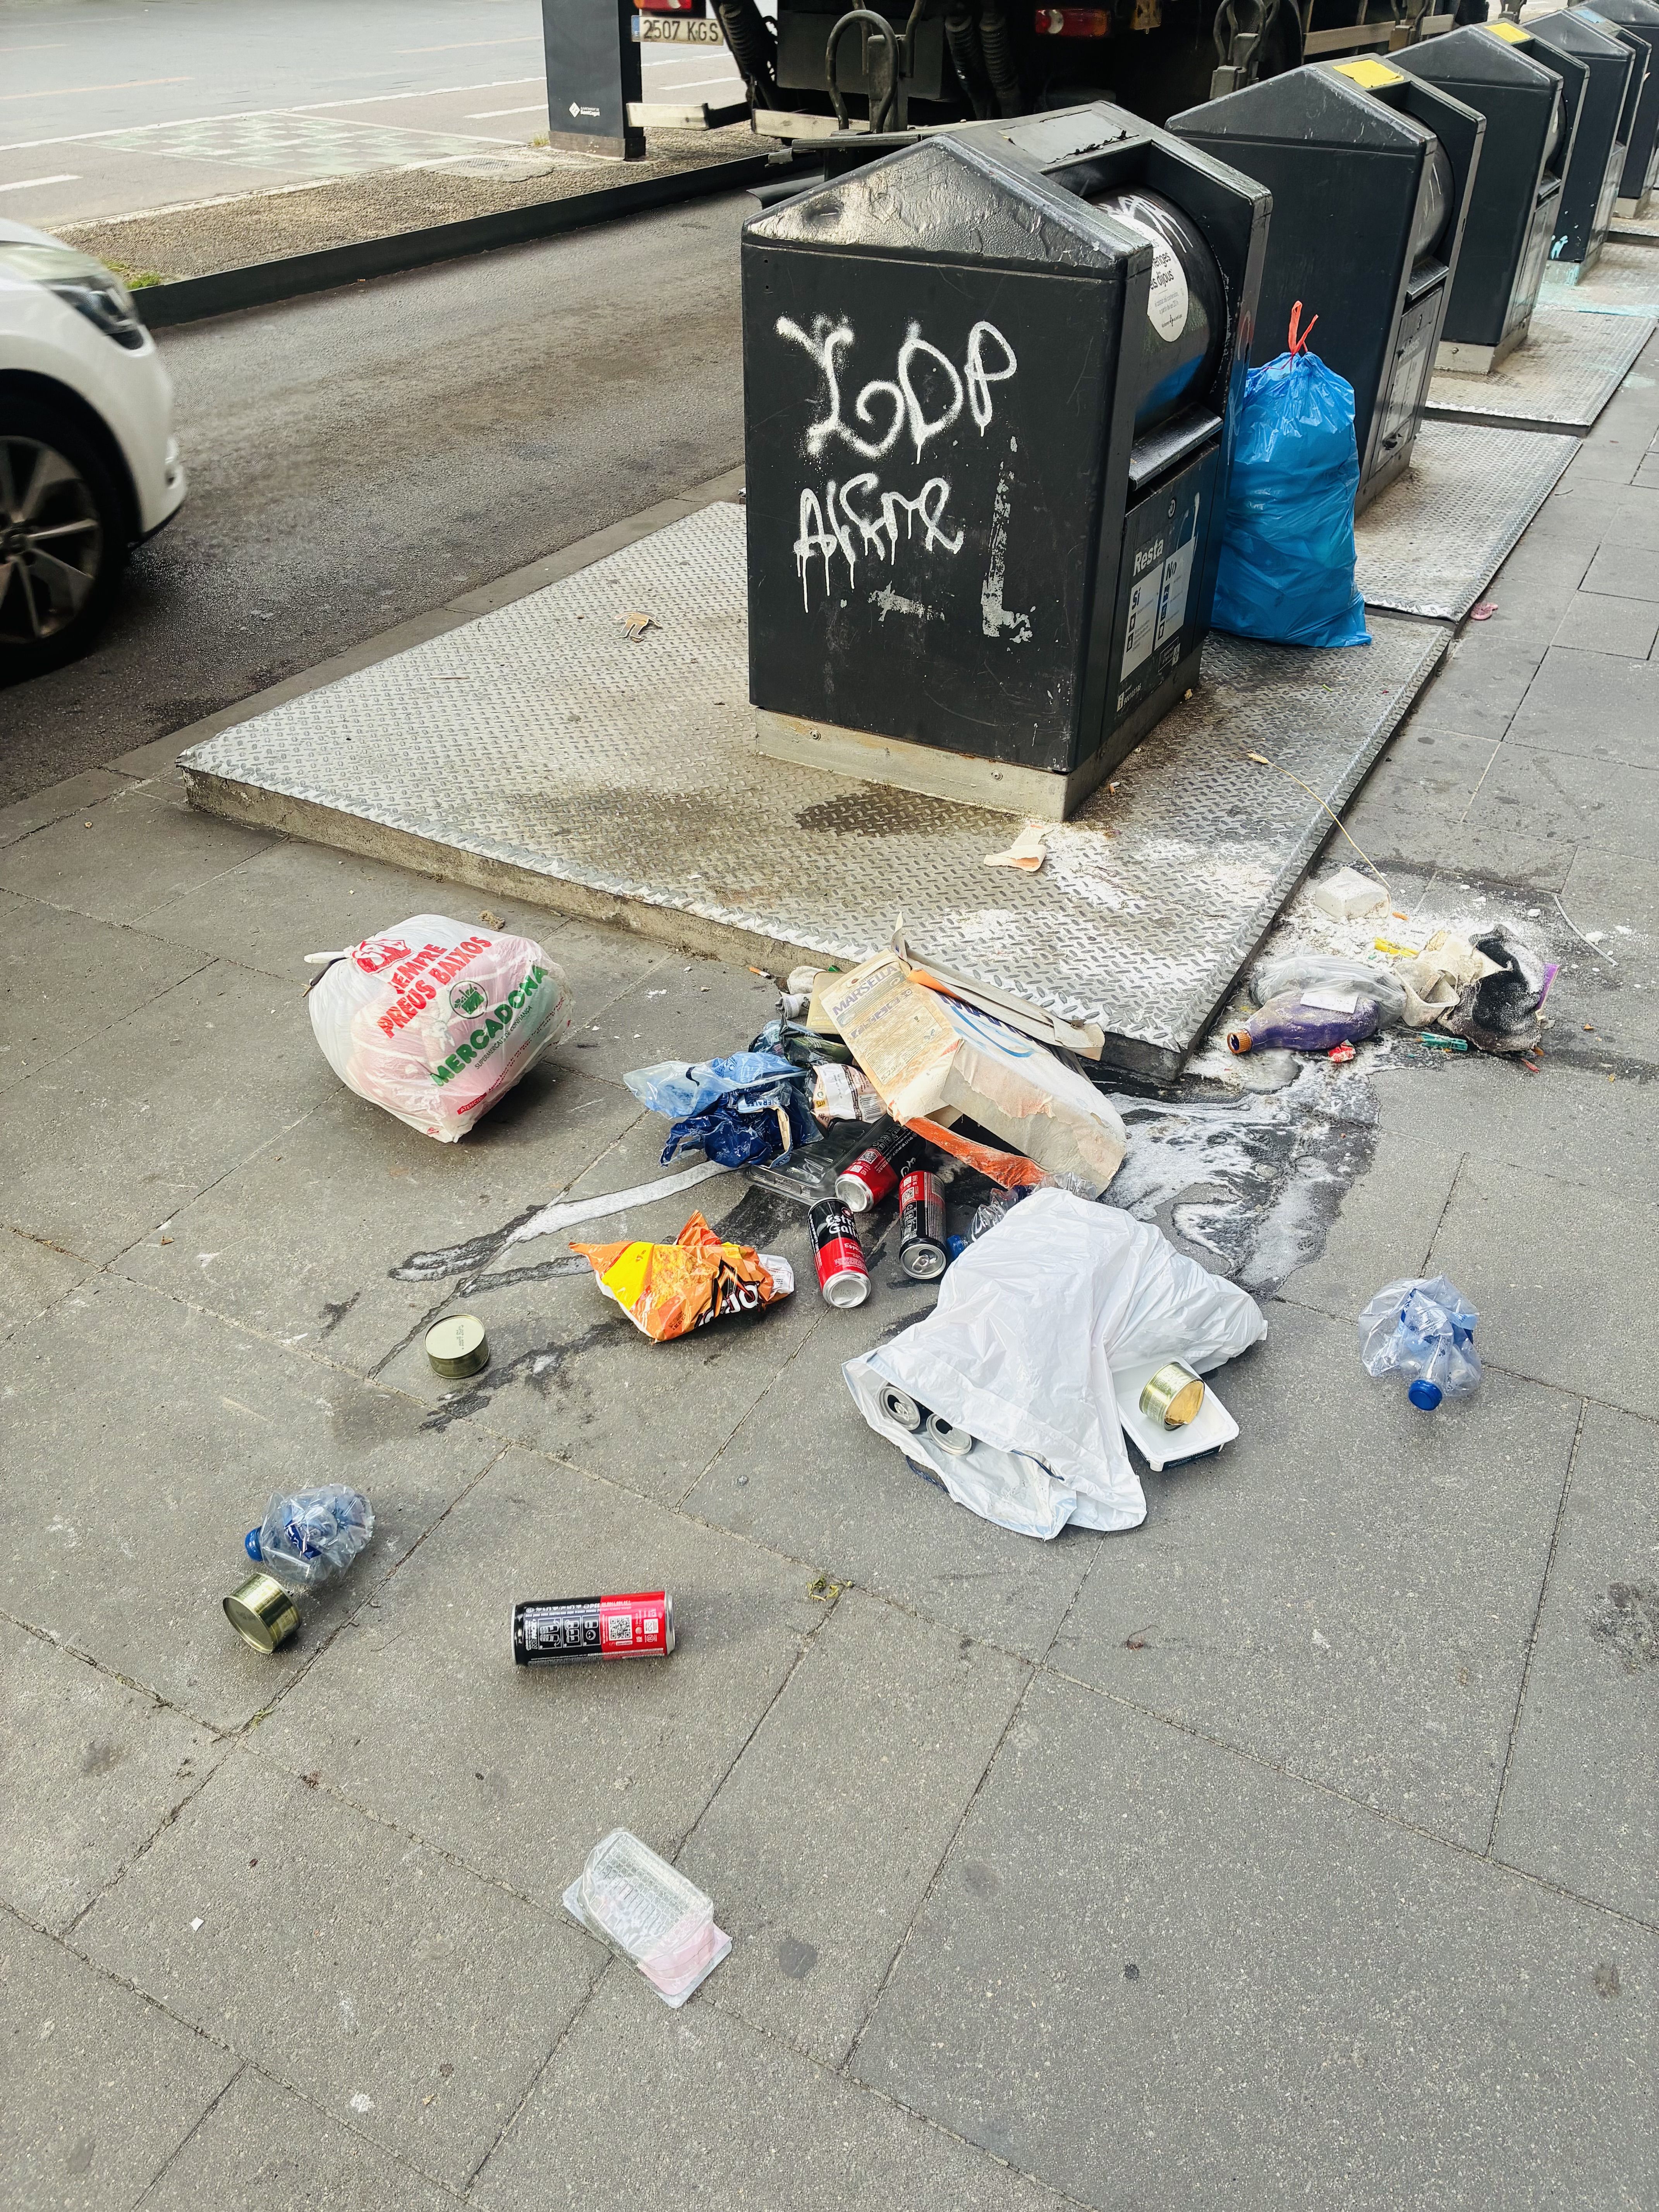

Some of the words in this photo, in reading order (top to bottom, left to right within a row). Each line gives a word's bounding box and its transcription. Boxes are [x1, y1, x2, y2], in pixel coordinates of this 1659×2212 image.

[643, 19, 680, 40] 2507
[687, 21, 719, 42] KGS
[1156, 270, 1174, 287] dijous
[1133, 539, 1164, 577] Resta
[1166, 561, 1177, 581] No
[376, 980, 436, 1039] PREUS
[428, 936, 492, 985] BAIXOS
[833, 965, 898, 1016] MARSELLA
[429, 965, 549, 1087] MERCADONA
[475, 1037, 507, 1070] SUPERMERCATS
